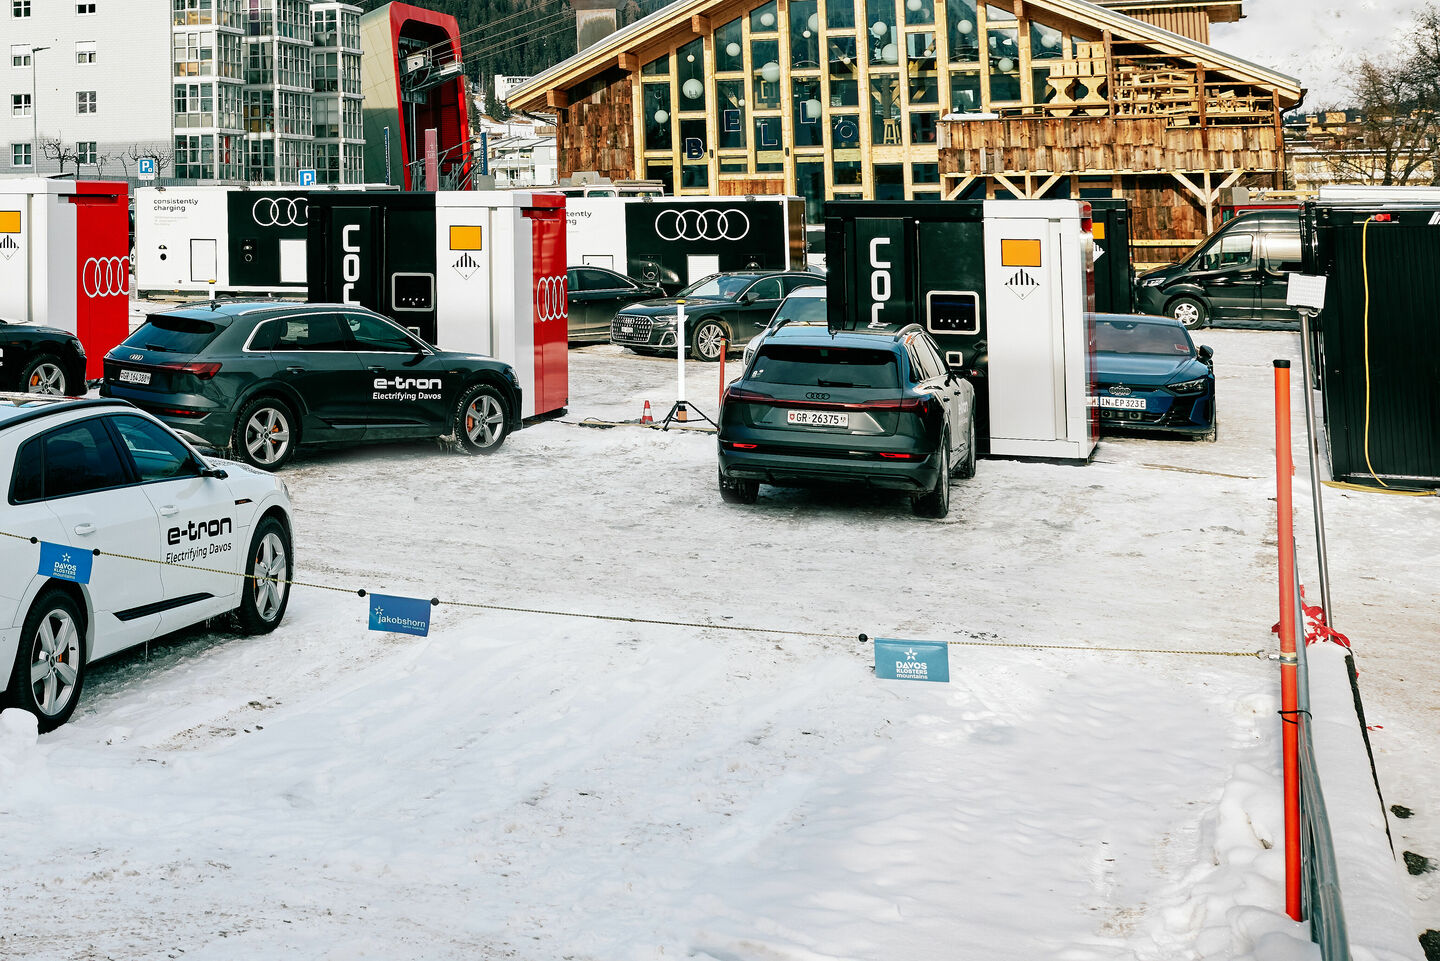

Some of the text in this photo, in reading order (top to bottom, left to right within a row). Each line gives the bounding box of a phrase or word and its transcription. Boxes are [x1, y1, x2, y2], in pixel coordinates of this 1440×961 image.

[142, 161, 150, 171] P
[304, 173, 311, 185] P
[342, 224, 361, 307] ron
[869, 237, 891, 325] ron
[373, 376, 442, 389] e-tron
[372, 392, 416, 401] Electrifying
[167, 517, 232, 546] e-tron
[165, 542, 232, 563] Electrifying Davos
[54, 561, 77, 571] DAVOS
[377, 615, 426, 628] jakobshorn
[896, 661, 928, 670] DAVOS
